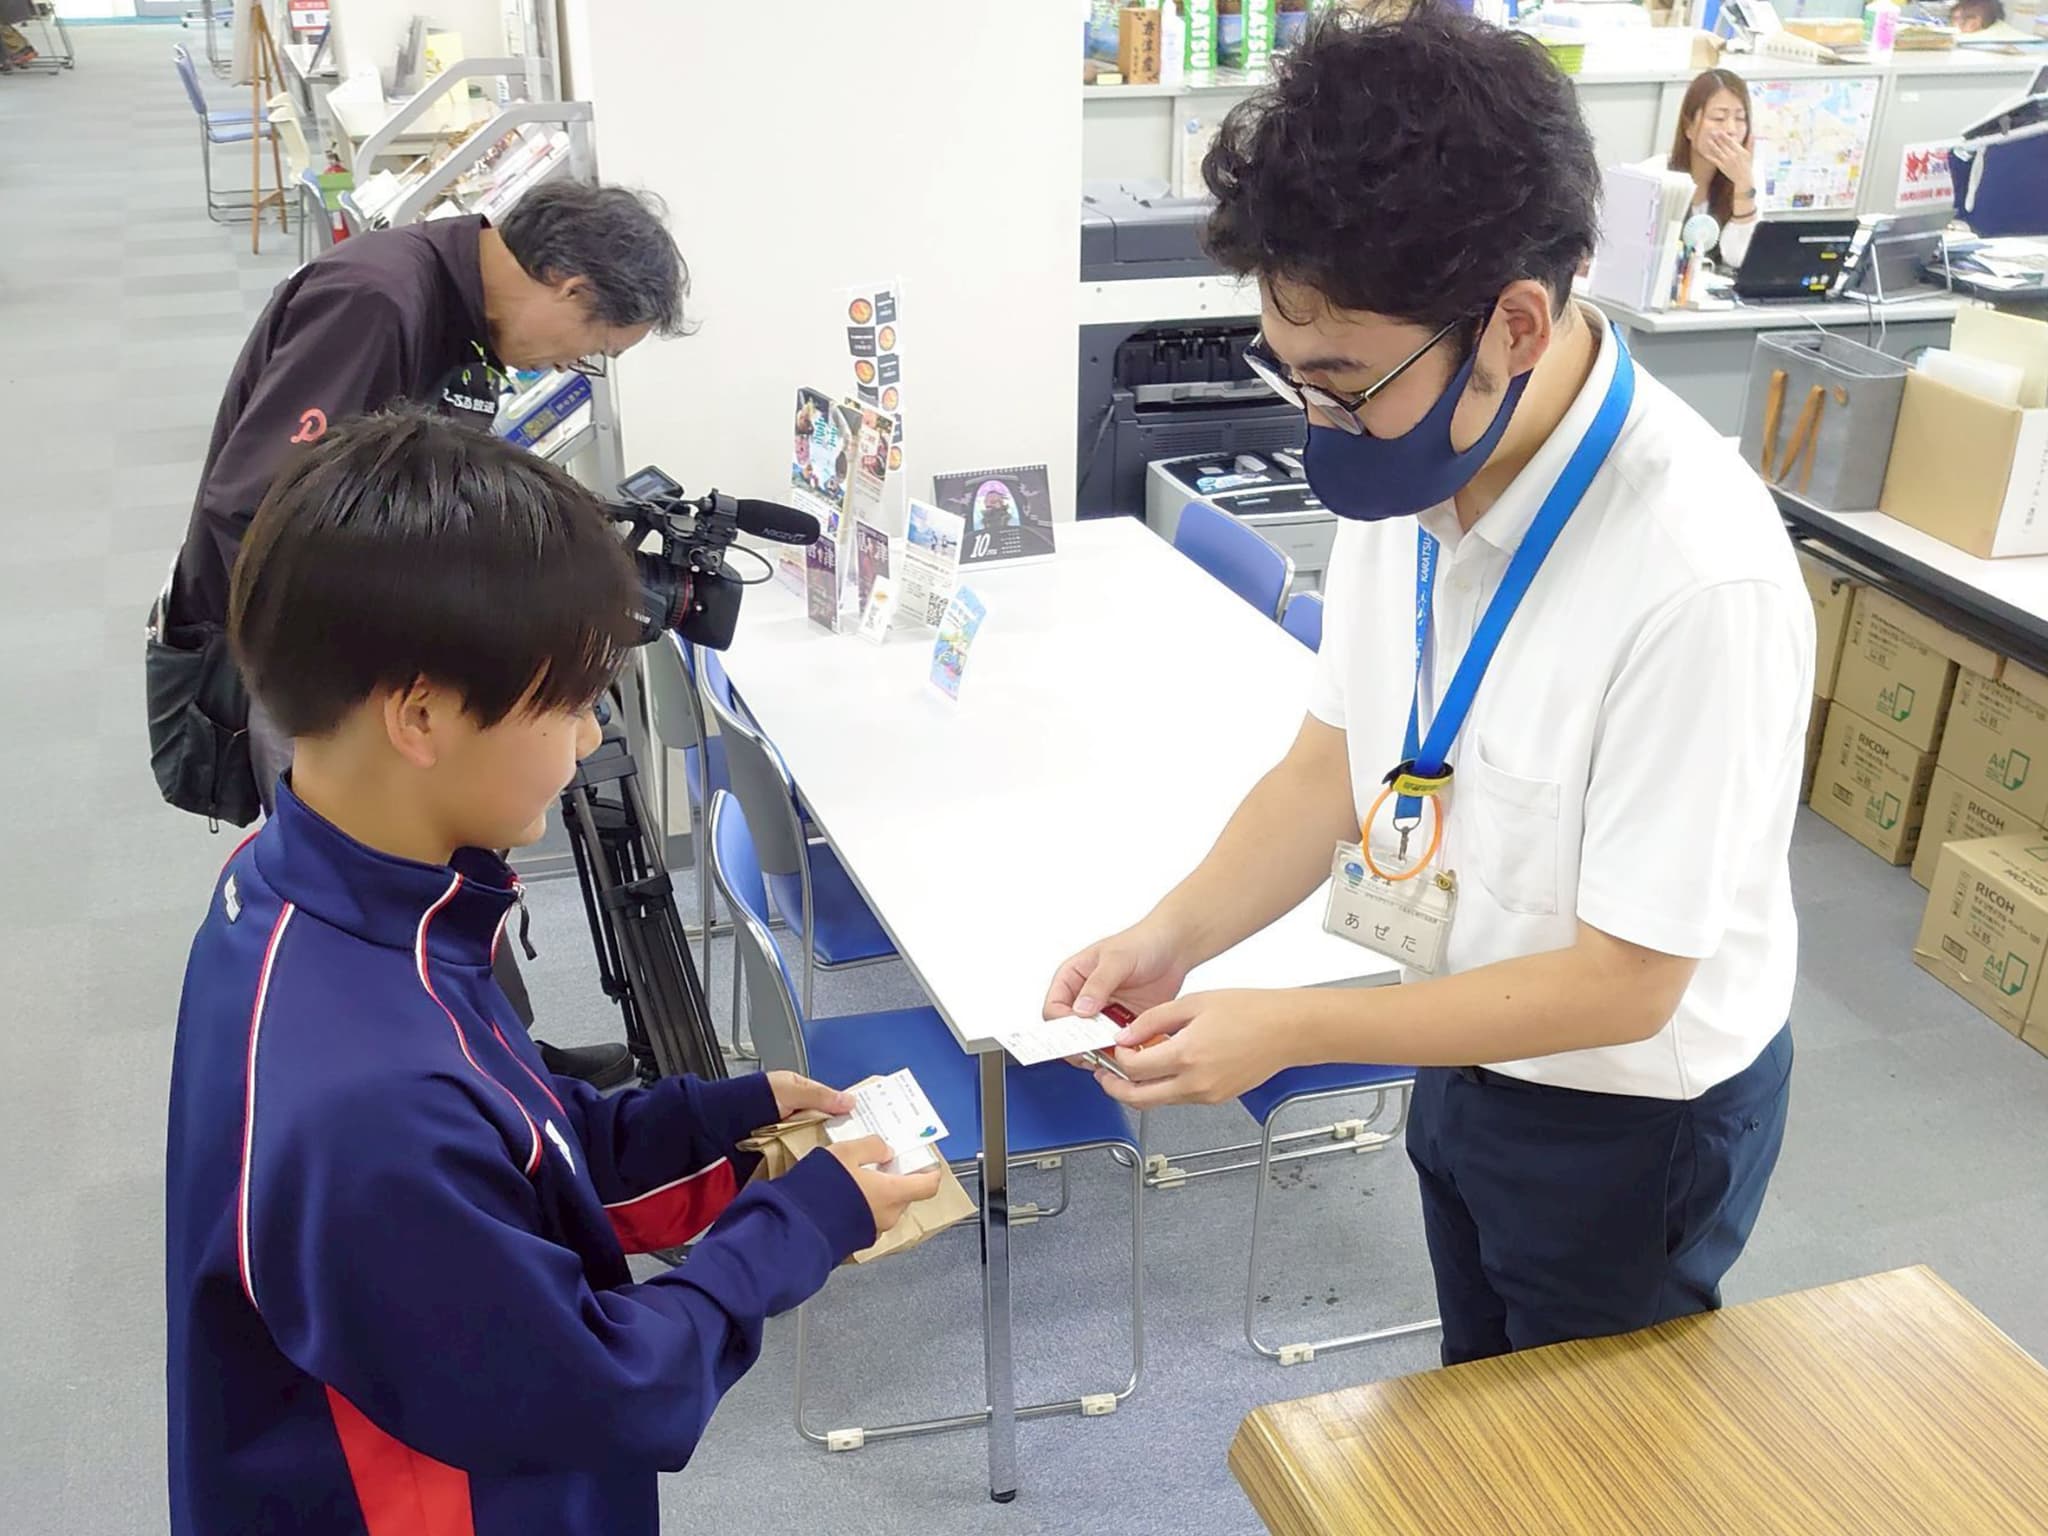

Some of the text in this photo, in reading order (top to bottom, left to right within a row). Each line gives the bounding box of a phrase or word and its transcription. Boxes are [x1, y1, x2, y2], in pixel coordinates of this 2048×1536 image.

[970, 533, 991, 558] 10
[1879, 687, 1895, 703] A4
[1859, 733, 1889, 759] RICOH
[1988, 753, 2006, 770] A4
[1968, 801, 2005, 832] RICOH
[1976, 881, 2015, 915] RICOH
[1985, 955, 2003, 973] A4
